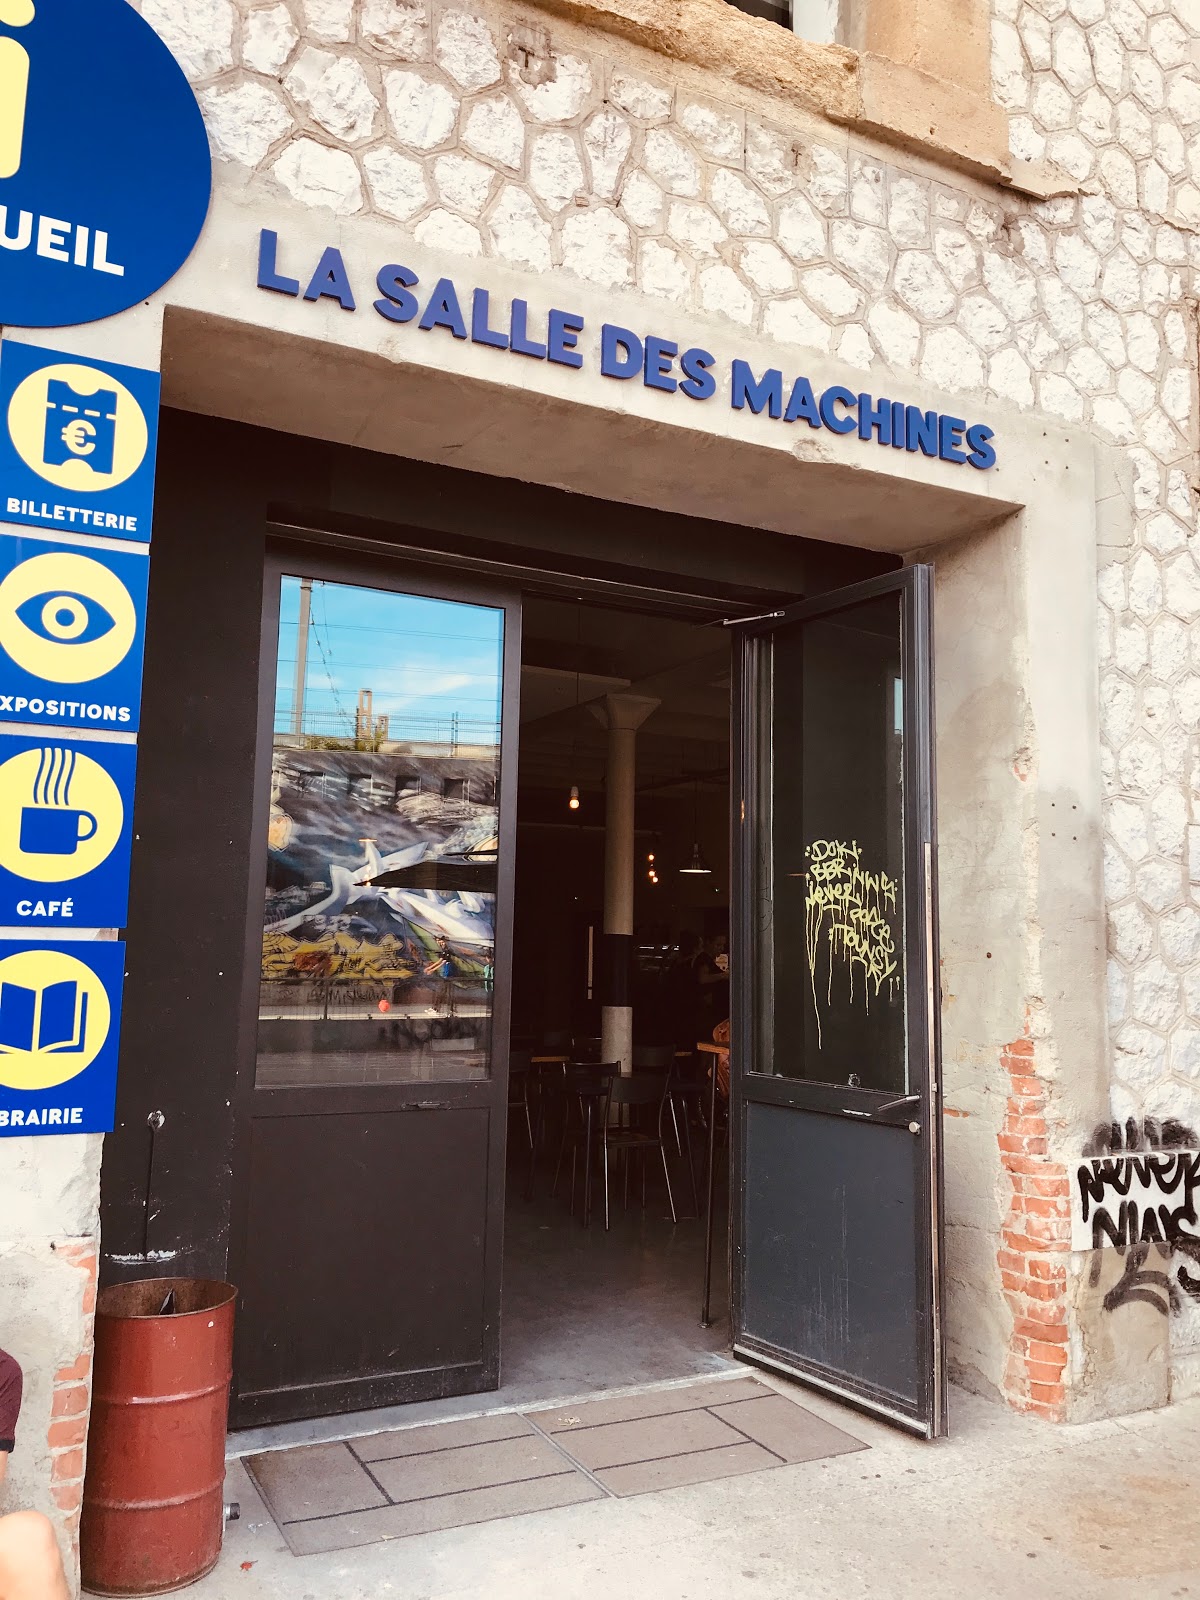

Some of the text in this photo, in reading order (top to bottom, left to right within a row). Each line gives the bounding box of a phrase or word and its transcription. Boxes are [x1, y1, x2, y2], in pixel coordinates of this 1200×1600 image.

[257, 228, 997, 470] LA SALLE DES MACHINES
[7, 497, 138, 532] BILLETTERIE
[0, 695, 131, 722] XPOSITIONS
[16, 897, 74, 917] CAFÉ
[0, 1107, 84, 1127] BRAIRIE
